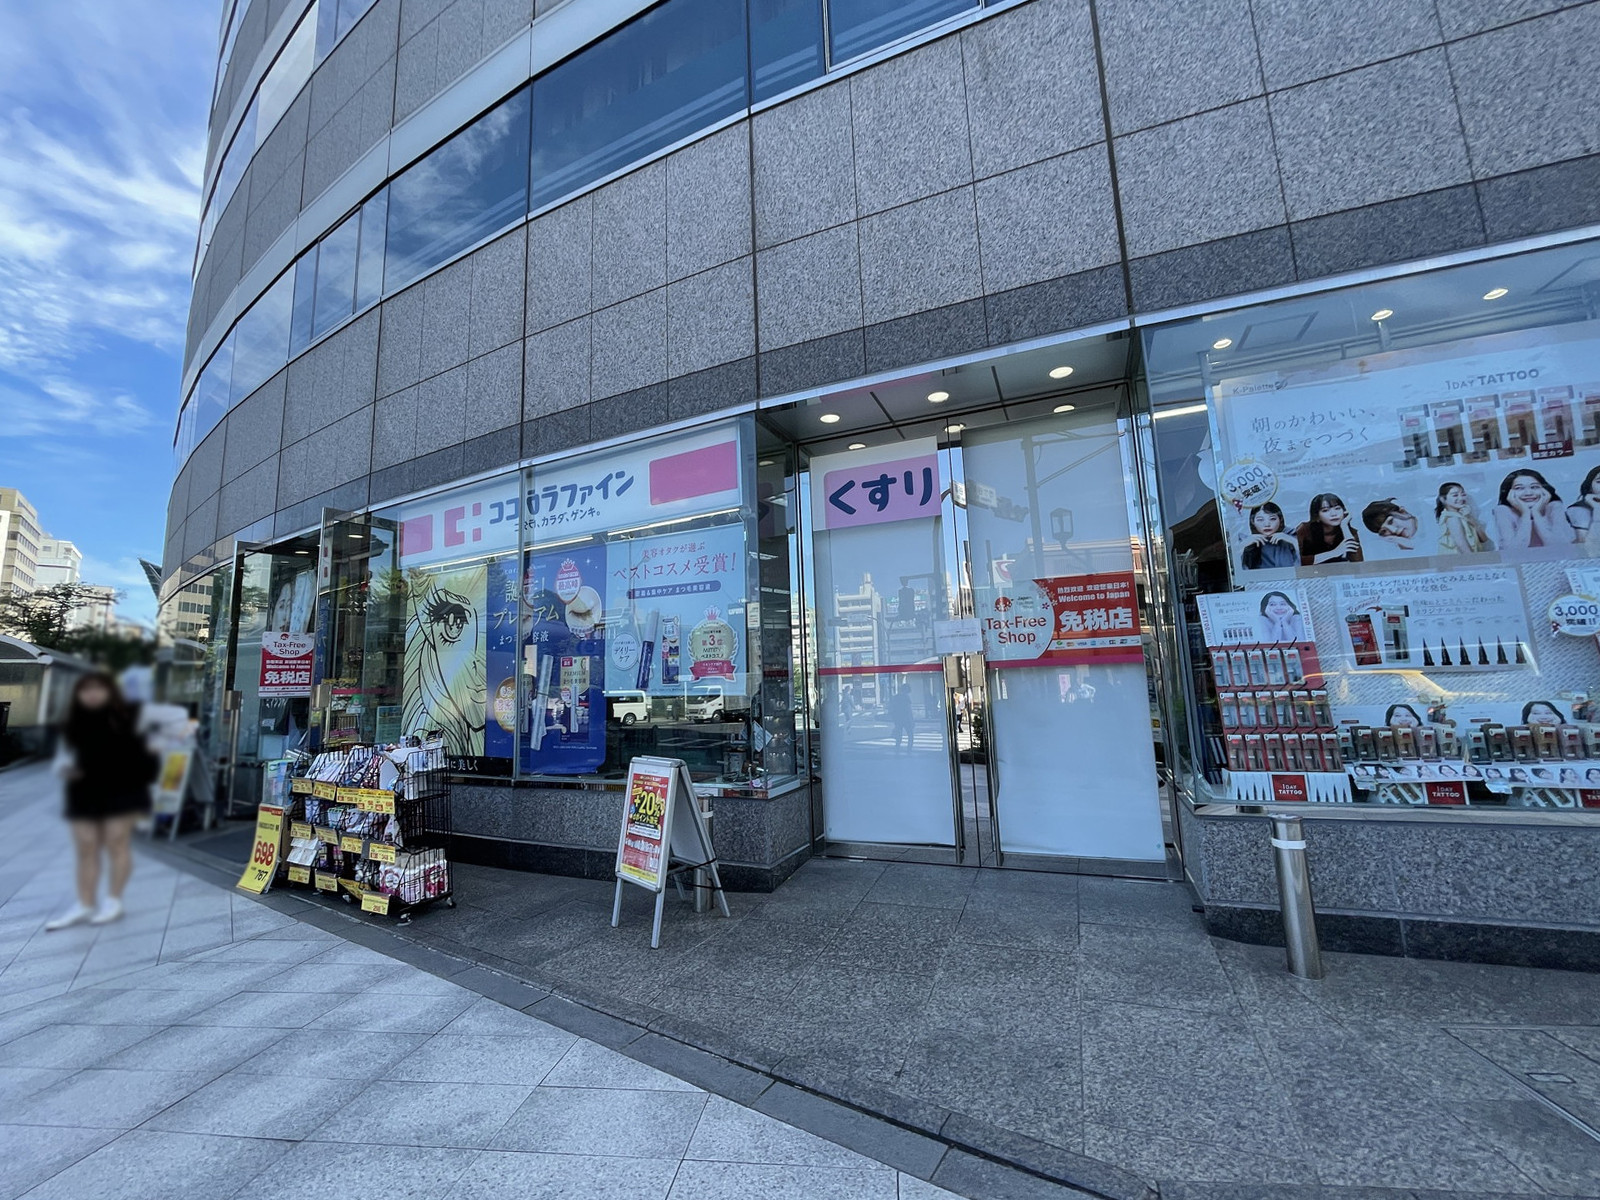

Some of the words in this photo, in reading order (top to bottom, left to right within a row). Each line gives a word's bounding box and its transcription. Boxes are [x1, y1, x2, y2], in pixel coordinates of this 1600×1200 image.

[1478, 368, 1540, 386] TATTOO
[1233, 383, 1274, 395] K-Palette
[1252, 407, 1375, 434] 朝のかわいい、
[1263, 427, 1369, 454] 夜までつづく
[1226, 467, 1264, 493] 3,000
[828, 467, 933, 516] くすり
[613, 552, 737, 580] ベストコスメ受賞!
[1058, 594, 1095, 603] Welcome
[1106, 591, 1130, 600] Japan
[493, 604, 559, 630] プレアム
[1554, 604, 1598, 617] 3,000
[985, 616, 1047, 630] Tax-Free
[1058, 607, 1133, 633] 免税店
[998, 631, 1036, 645] Shop
[279, 648, 300, 656] Shop
[264, 670, 310, 684] 免税店
[254, 841, 275, 866] 698
[254, 869, 268, 882] 767
